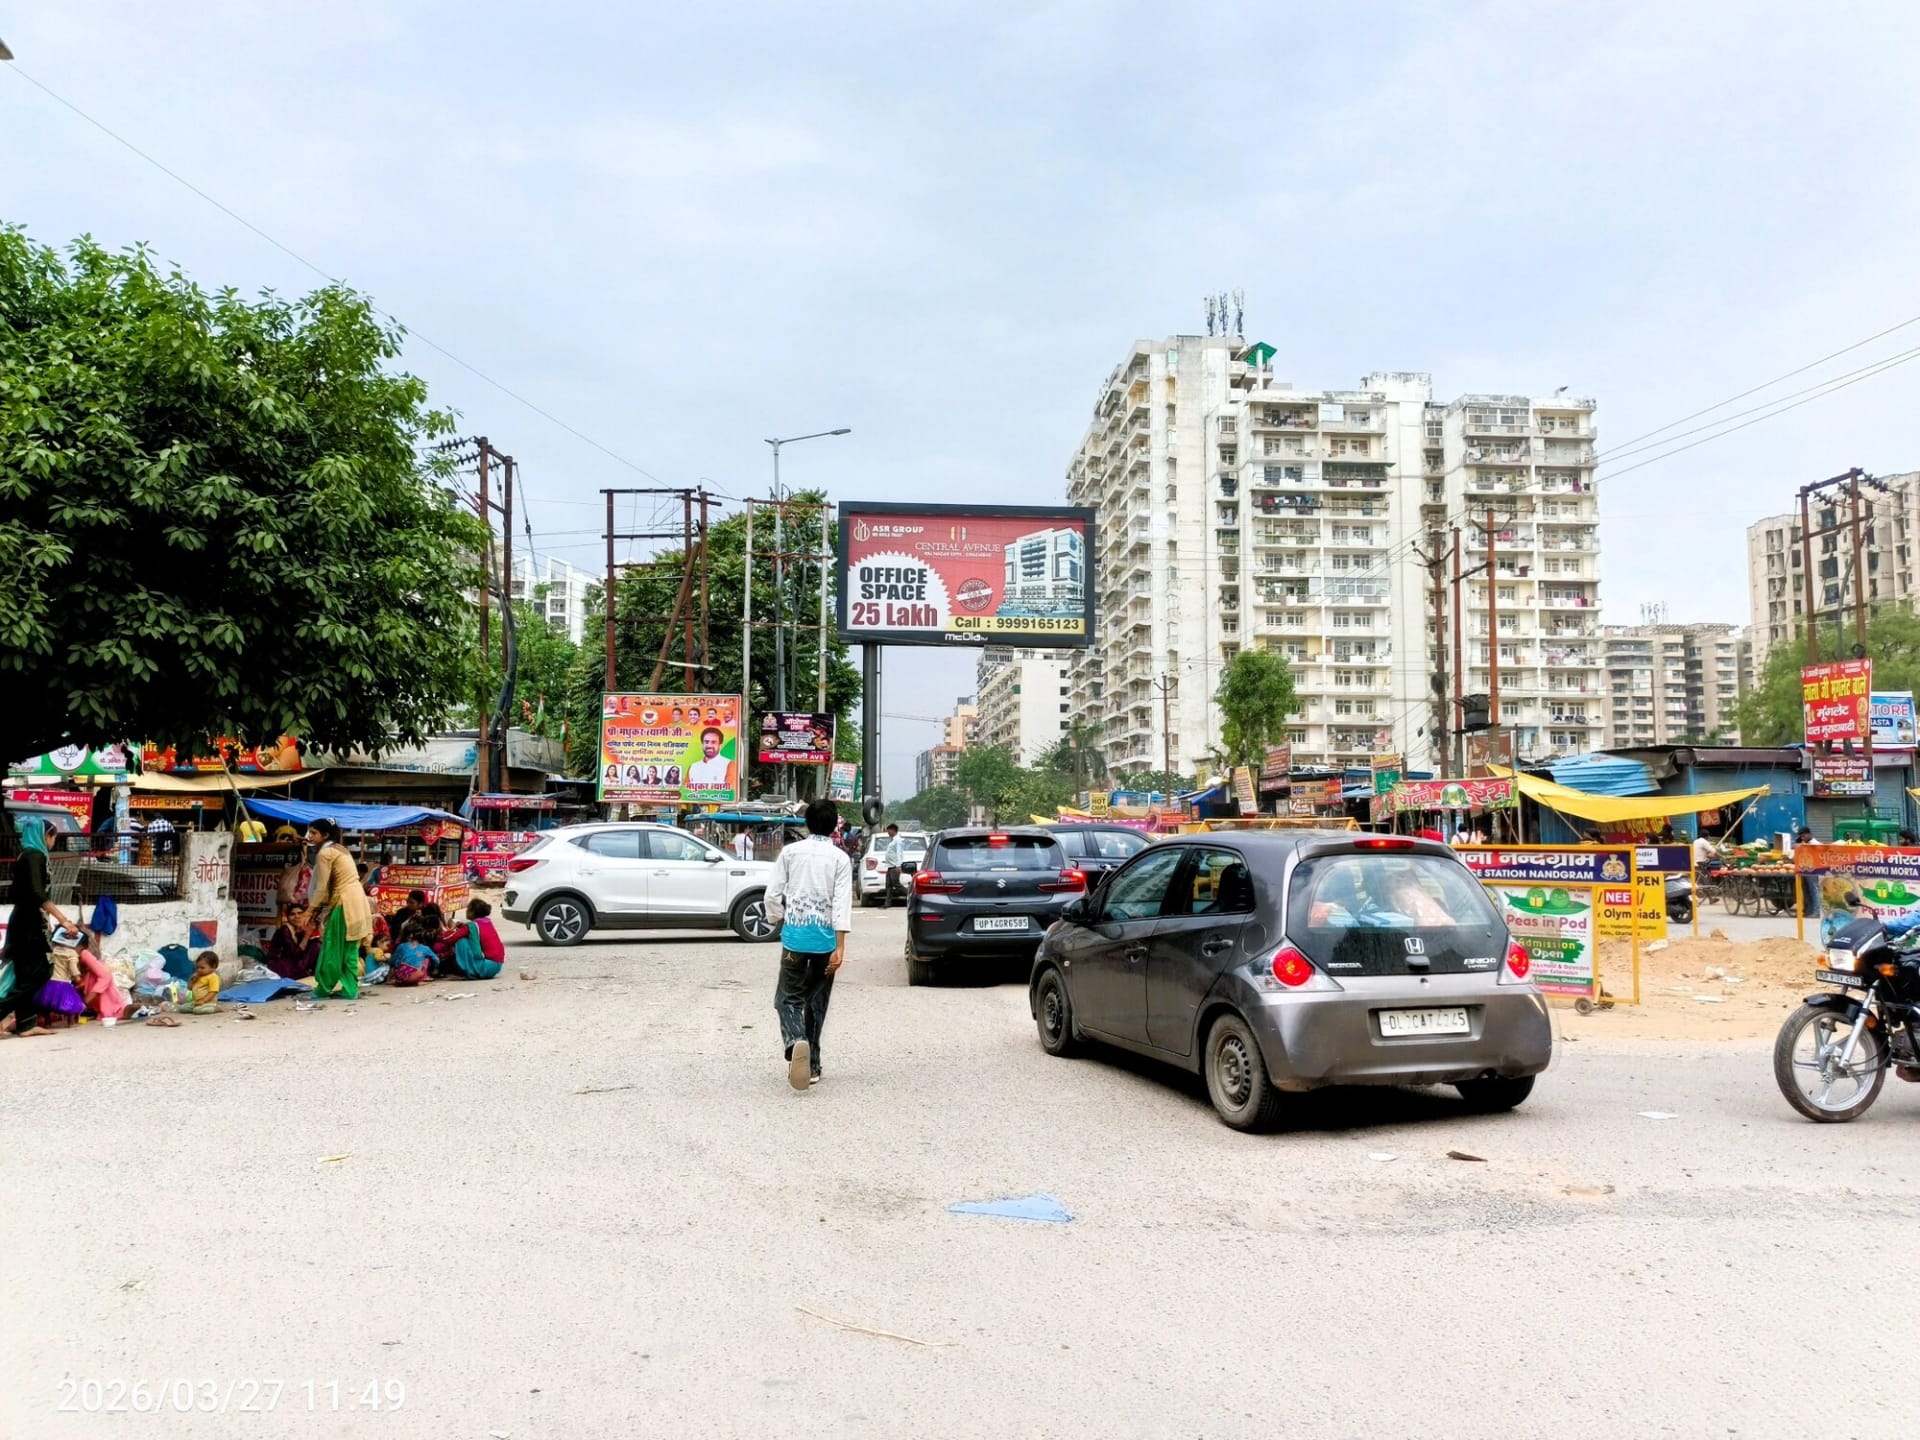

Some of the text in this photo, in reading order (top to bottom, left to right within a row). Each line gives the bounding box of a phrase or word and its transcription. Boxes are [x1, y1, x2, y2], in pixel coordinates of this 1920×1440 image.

[872, 525, 924, 534] ASR GROUP
[915, 542, 1001, 553] CENTRAL AVENUE
[860, 566, 928, 584] OFFICE
[861, 583, 926, 601] SPACE
[852, 602, 938, 627] 25 Lakh
[955, 616, 981, 628] Call
[996, 617, 1079, 630] 9999165123
[1871, 704, 1909, 716] TORE
[646, 727, 669, 737] त्यागी
[671, 728, 683, 737] जी
[1818, 852, 1851, 866] पुलिस
[1855, 850, 1885, 864] चौकी
[1484, 869, 1527, 878] STATION
[1529, 870, 1594, 881] NANDGRAM
[1830, 864, 1919, 877] POLICE CHOWKI MORTA
[234, 874, 281, 891] EMATICS
[1606, 893, 1632, 903] NEE
[1604, 910, 1661, 922] Olymiads
[1887, 906, 1897, 917] in
[1506, 914, 1588, 930] Peas in Pod
[1518, 938, 1576, 950] Admission
[1532, 948, 1565, 960] Open
